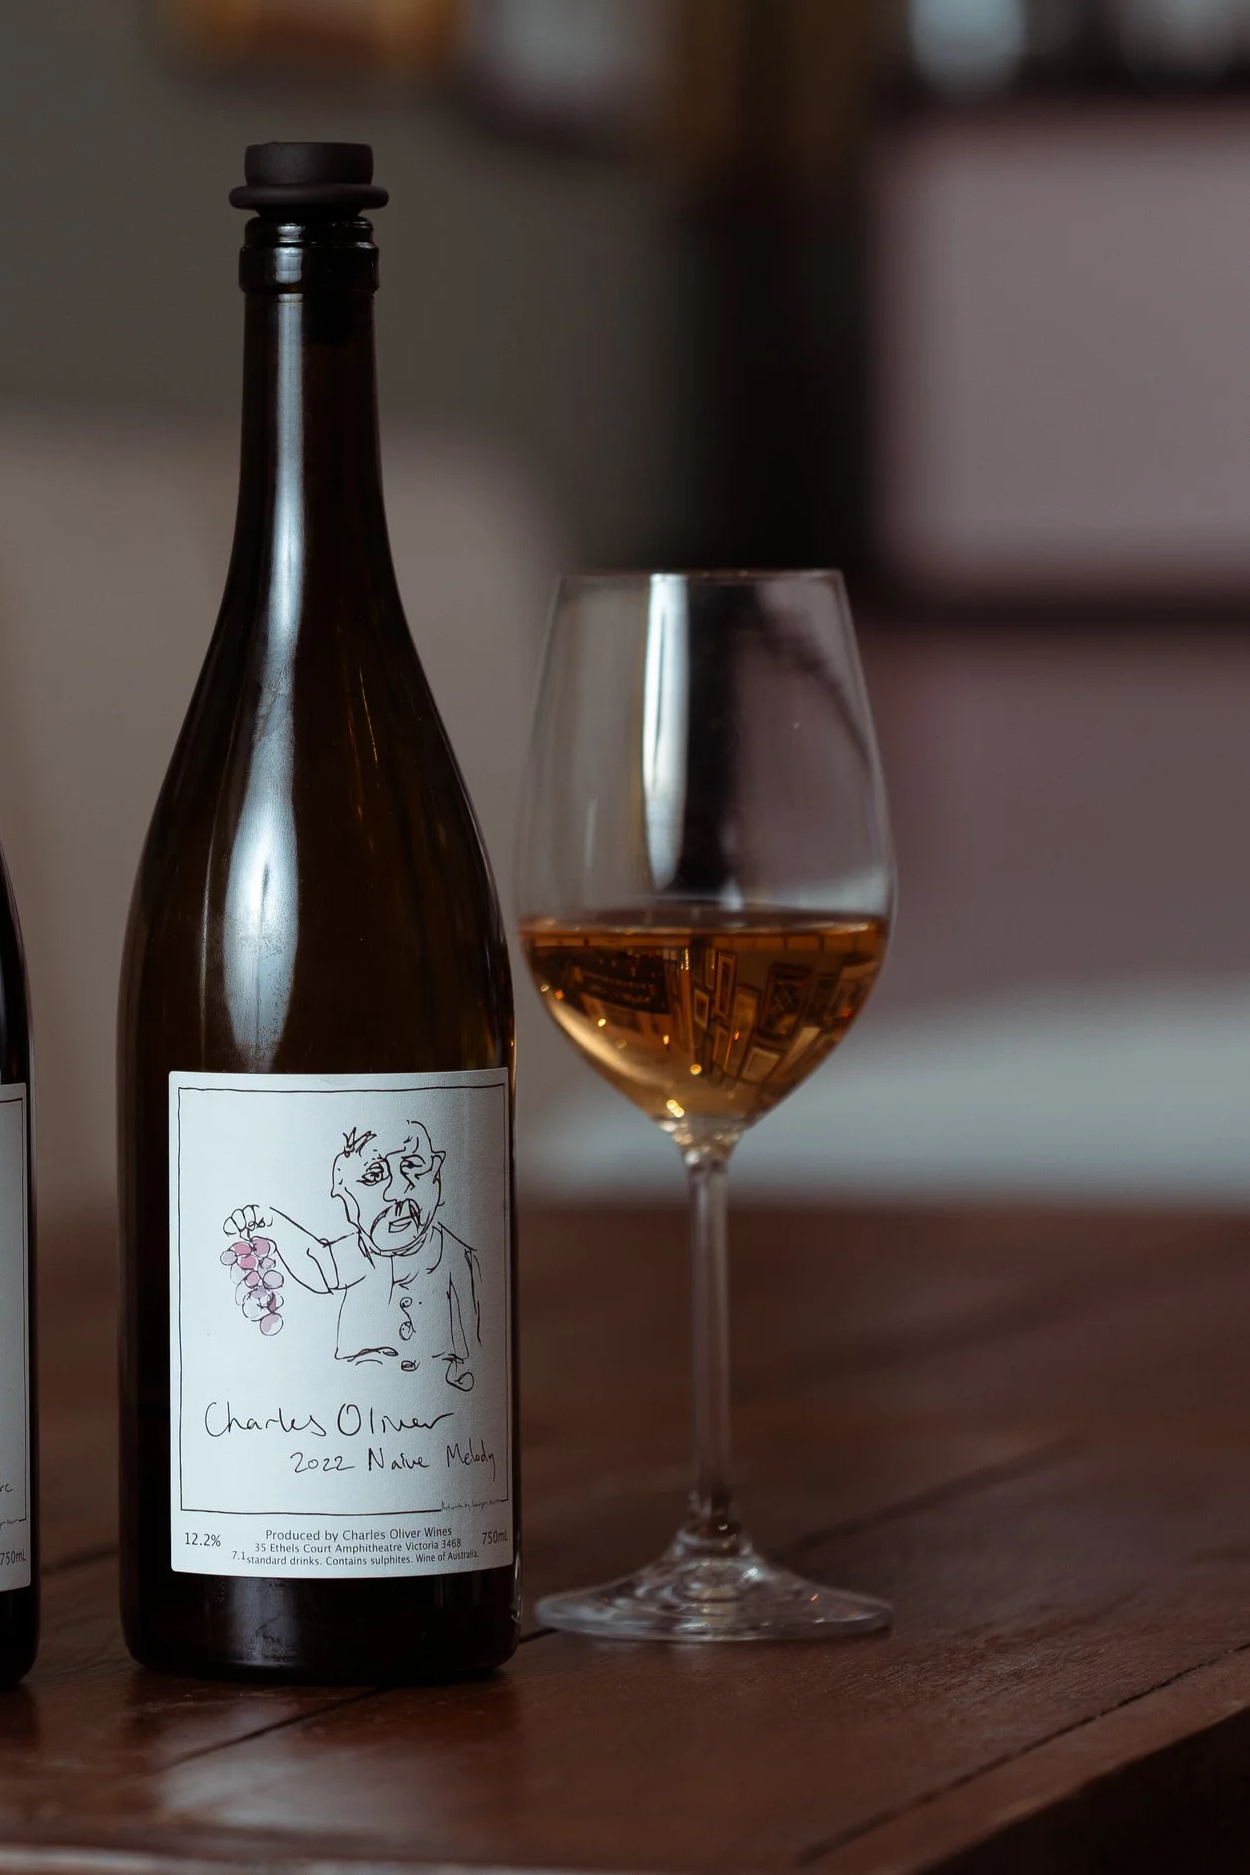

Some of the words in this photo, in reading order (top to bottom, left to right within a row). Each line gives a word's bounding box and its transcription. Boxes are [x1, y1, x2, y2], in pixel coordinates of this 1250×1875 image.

[205, 1401, 327, 1438] Charles
[337, 1403, 454, 1436] Oliver
[290, 1452, 355, 1473] 2022
[446, 1438, 496, 1483] Melody
[184, 1532, 221, 1547] 12.2%
[265, 1529, 320, 1541] Produced
[324, 1530, 339, 1543] by
[342, 1529, 386, 1541] Charles
[389, 1528, 421, 1540] Oliver
[424, 1527, 452, 1537] Wines
[481, 1530, 509, 1546] 750mL
[254, 1543, 267, 1553] 35
[270, 1543, 300, 1553] Ethels
[303, 1543, 331, 1553] Court
[335, 1542, 402, 1555] Amphitheatre
[405, 1541, 439, 1552] Victoria
[441, 1538, 462, 1549] 3468
[0, 1550, 27, 1566] 750mL
[231, 1550, 245, 1561] 7.1
[246, 1556, 287, 1565] standard
[289, 1556, 323, 1566] drinks.
[325, 1556, 368, 1567] Contains
[370, 1553, 414, 1567] sulphites.
[415, 1552, 435, 1564] Wine
[438, 1551, 447, 1561] of
